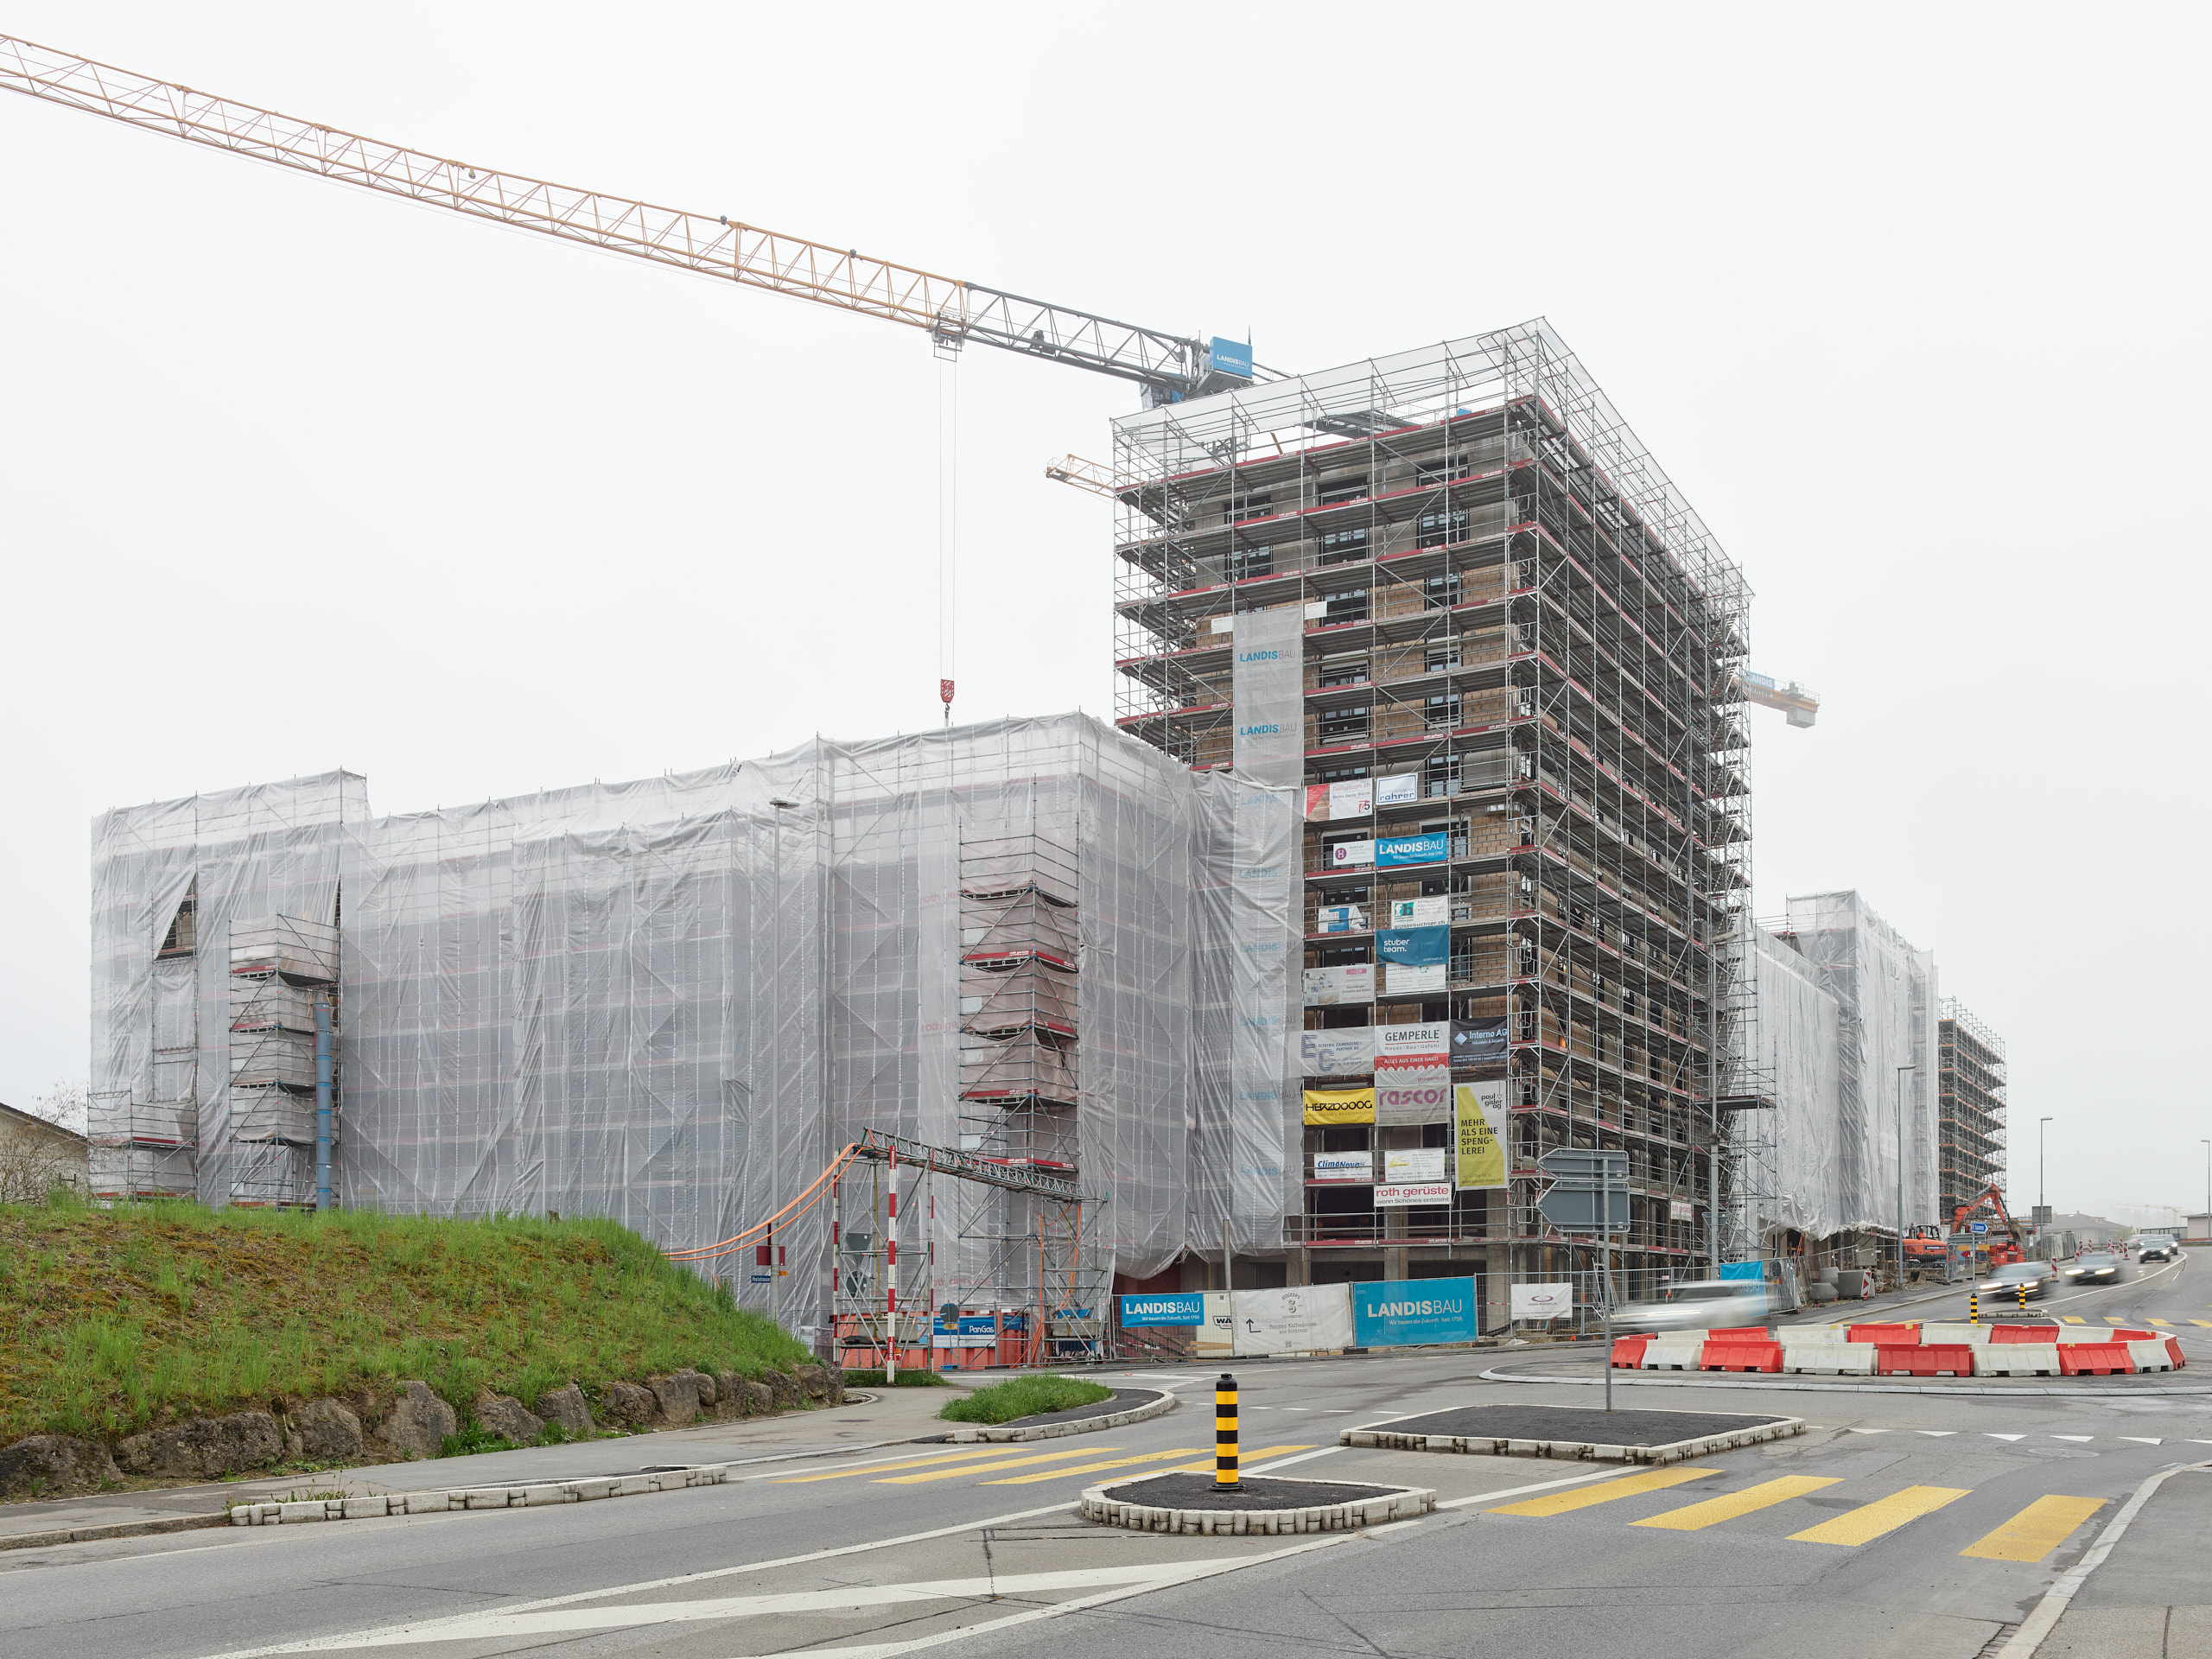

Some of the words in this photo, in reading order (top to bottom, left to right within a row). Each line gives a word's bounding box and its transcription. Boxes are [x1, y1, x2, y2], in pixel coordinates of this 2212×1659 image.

[1217, 354, 1249, 367] LANDISBAU
[1240, 649, 1296, 662] LANDISBAU
[1241, 721, 1297, 735] LANDISBAU
[1380, 792, 1414, 801] rohrer
[1379, 840, 1444, 855] LANDISBAU
[1395, 904, 1414, 917] fb
[1385, 1030, 1440, 1041] GEMPERLE
[1496, 1028, 1507, 1037] AG
[1379, 1087, 1446, 1106] rascor
[1485, 1098, 1503, 1107] gisler
[1462, 1137, 1493, 1146] SPENG-
[1462, 1147, 1484, 1155] LEREI
[1376, 1187, 1399, 1197] roth
[1403, 1186, 1448, 1198] gerüste
[1126, 1301, 1199, 1314] LANDISBAU
[1367, 1300, 1462, 1318] LANDISBAU
